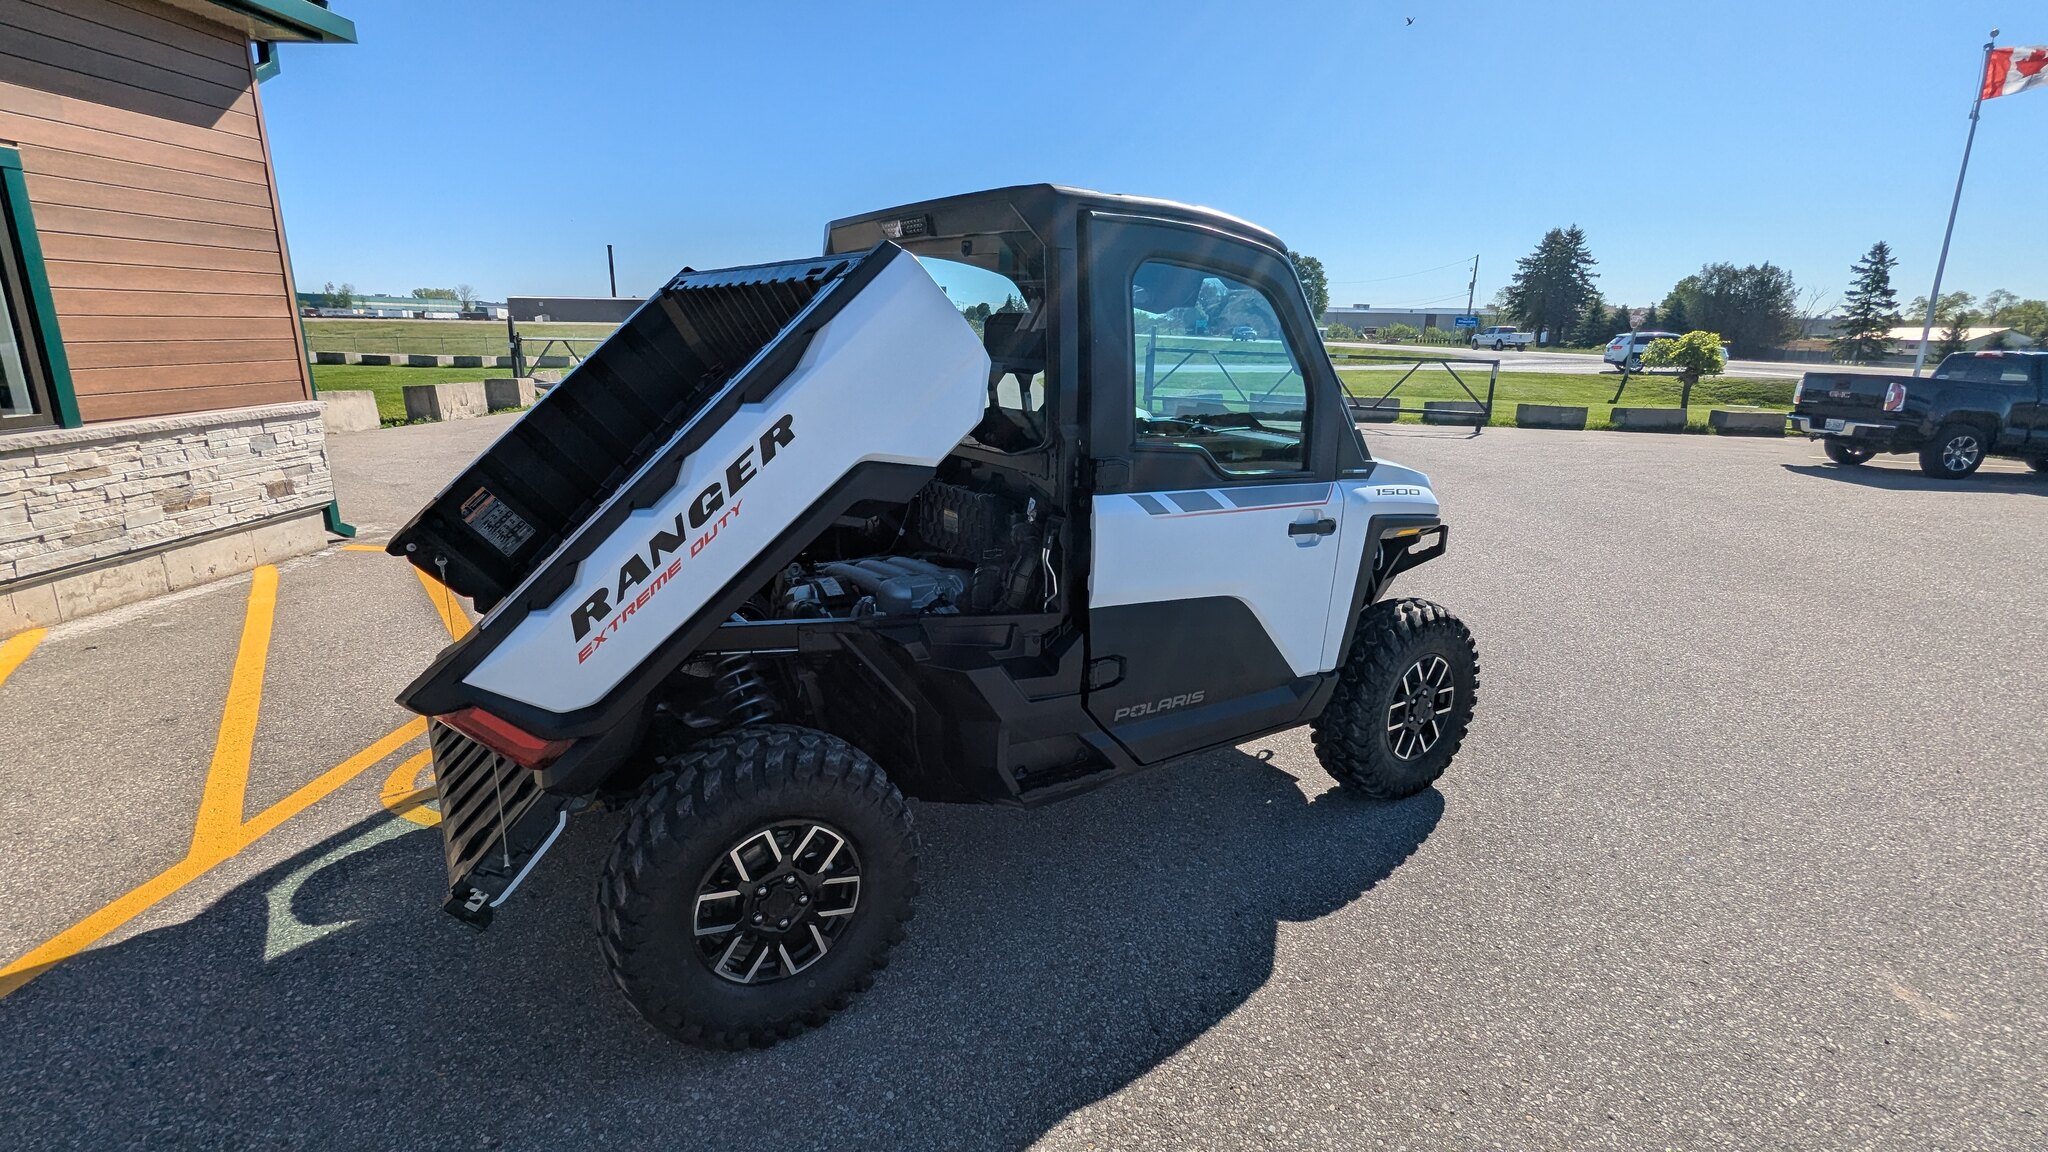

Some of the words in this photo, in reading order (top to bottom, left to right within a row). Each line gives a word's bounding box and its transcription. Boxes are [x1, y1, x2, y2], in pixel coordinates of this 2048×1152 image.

[570, 413, 796, 643] RANGER
[1375, 488, 1421, 496] 1500
[578, 558, 682, 665] EXTREME
[690, 498, 744, 558] DUTY
[1113, 690, 1206, 722] POLARIS
